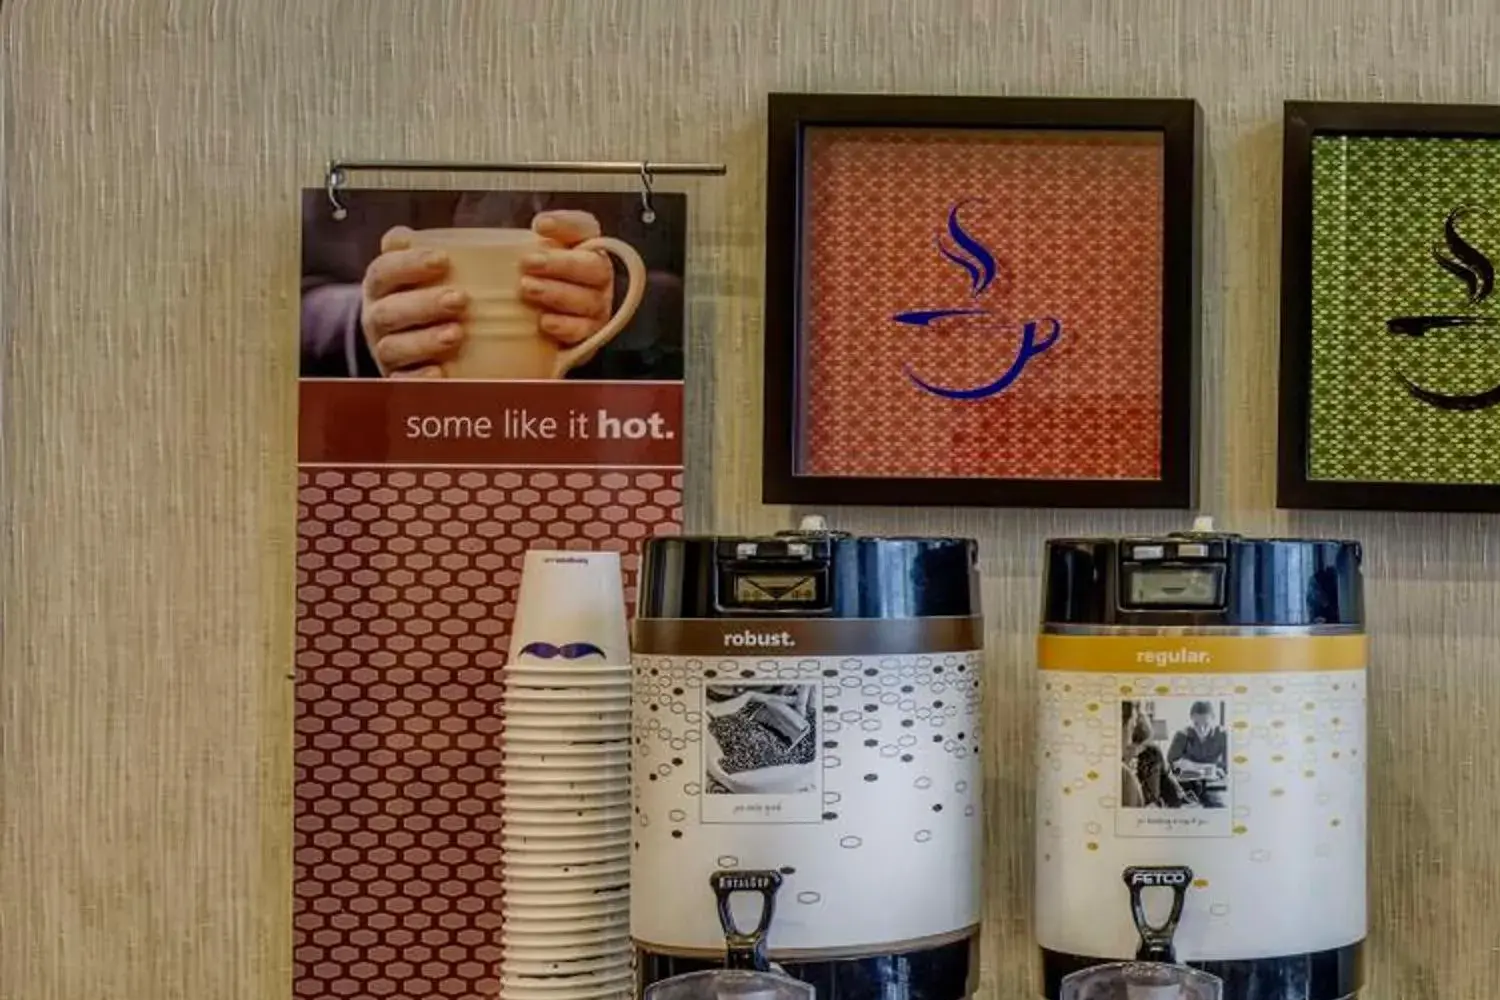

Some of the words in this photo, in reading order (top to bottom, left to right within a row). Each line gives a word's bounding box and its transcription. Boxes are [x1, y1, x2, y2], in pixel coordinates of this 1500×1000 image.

[406, 414, 492, 439] some
[504, 409, 557, 439] like
[569, 410, 589, 439] it
[597, 409, 675, 440] hot.
[724, 629, 796, 647] robust.
[1136, 646, 1211, 667] regular.
[1132, 872, 1185, 885] FETCO
